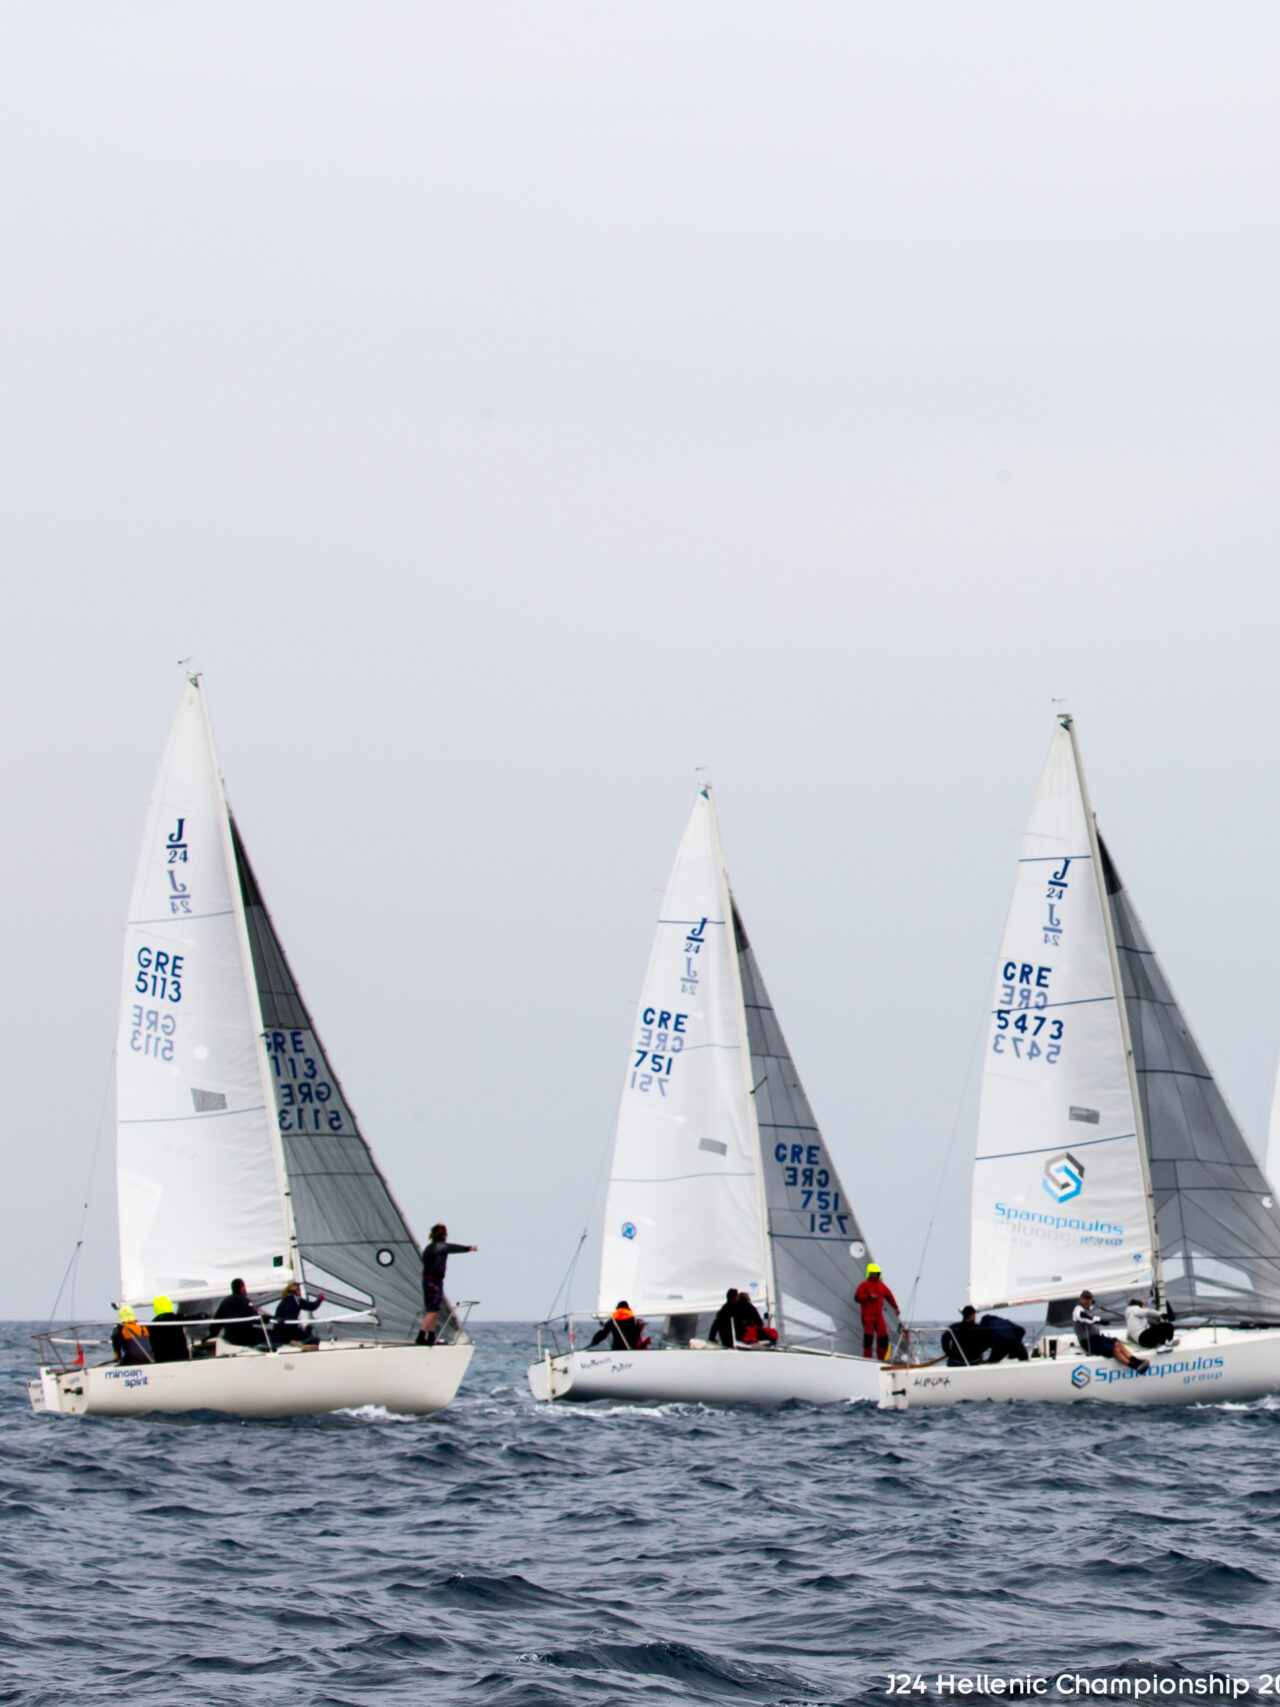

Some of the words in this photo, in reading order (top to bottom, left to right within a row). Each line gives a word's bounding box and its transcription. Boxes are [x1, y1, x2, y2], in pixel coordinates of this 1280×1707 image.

[168, 818, 185, 843] J
[168, 847, 188, 864] 24
[1053, 858, 1071, 880] J
[1046, 887, 1064, 900] 24
[691, 917, 708, 936] J
[683, 942, 700, 954] 24
[137, 947, 185, 979] GRE
[1003, 961, 1052, 988] GRE
[135, 970, 182, 1004] 5113
[642, 1007, 689, 1033] GRE
[996, 1010, 1064, 1040] 5473
[271, 1055, 317, 1079] 113
[634, 1050, 673, 1076] 751
[774, 1143, 820, 1165] GRE
[801, 1190, 838, 1212] 751
[995, 1202, 1124, 1236] Spanopoulos
[105, 1368, 142, 1379] minoan
[124, 1376, 148, 1388] spirit
[1183, 1371, 1222, 1384] group
